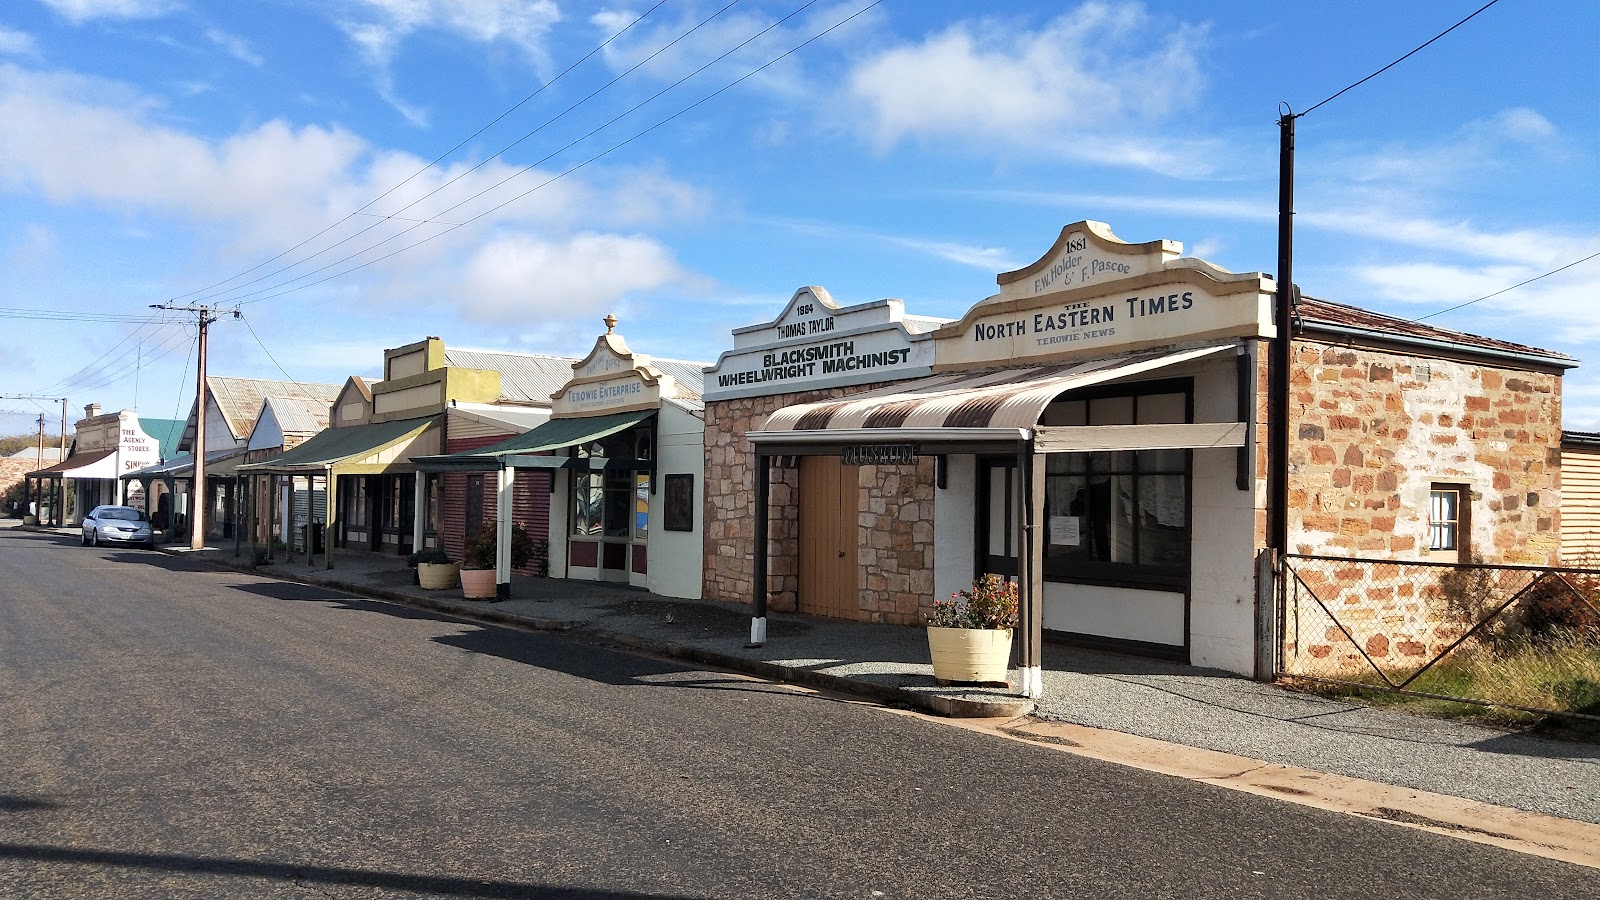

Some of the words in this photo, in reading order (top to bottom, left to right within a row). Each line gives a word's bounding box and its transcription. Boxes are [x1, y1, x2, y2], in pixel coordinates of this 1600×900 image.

[1065, 237, 1087, 254] 1881
[1050, 256, 1083, 282] Holder
[1091, 258, 1130, 276] Pascoe
[797, 303, 814, 317] 1884
[975, 319, 1026, 342] NORTH
[1034, 305, 1114, 333] EASTERN
[1126, 291, 1193, 318] TIMES
[1064, 301, 1091, 311] THE
[777, 322, 806, 339] THOMAS
[808, 316, 835, 335] TAYLOR
[1036, 332, 1080, 346] TEROWIE
[1083, 327, 1116, 340] NEWS
[763, 341, 854, 368] BLACKSMITH
[718, 362, 815, 387] WHEELWRIGHT
[822, 348, 911, 375] MACHINIST
[568, 389, 598, 403] TEROWIE
[599, 382, 641, 399] ENTERPRISE
